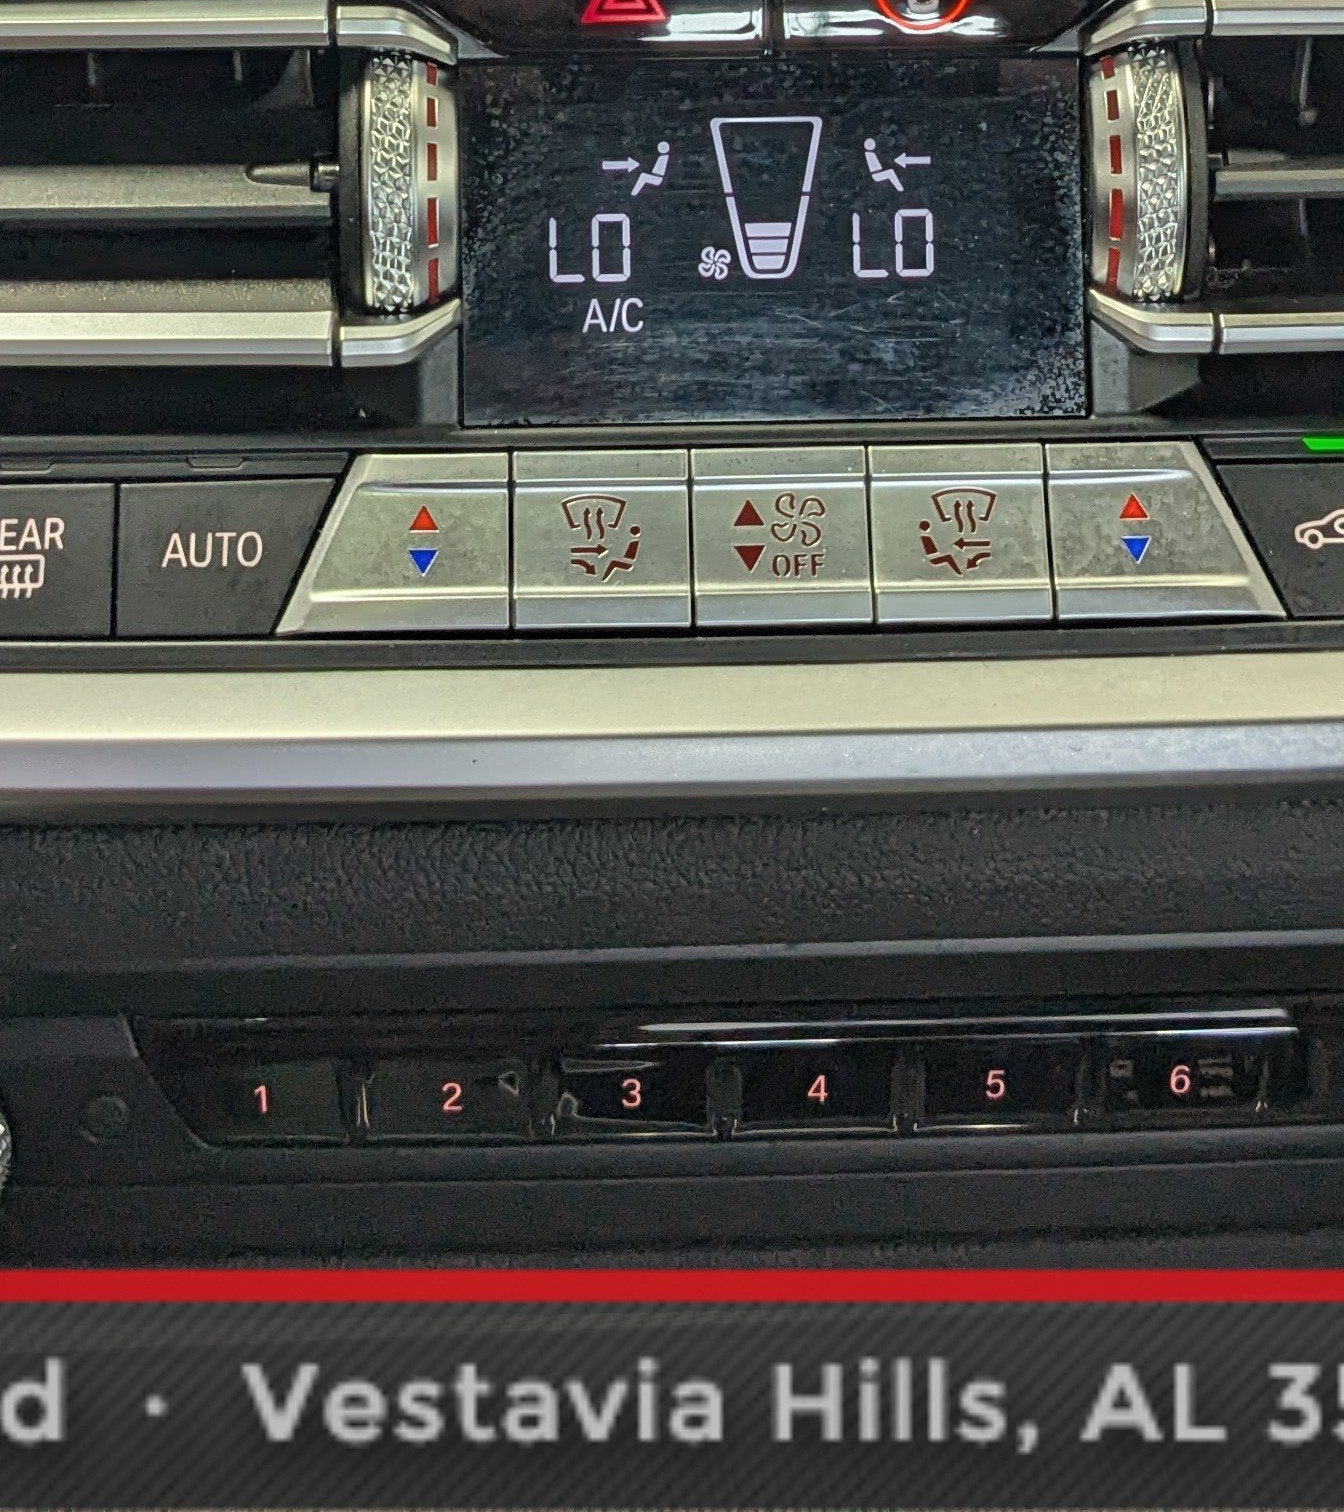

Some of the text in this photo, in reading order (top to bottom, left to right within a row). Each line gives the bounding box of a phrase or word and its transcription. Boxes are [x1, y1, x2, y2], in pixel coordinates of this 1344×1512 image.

[582, 297, 644, 333] A/C
[161, 530, 264, 569] AUTO
[771, 551, 825, 579] OFF
[621, 1078, 642, 1109] 3
[806, 1073, 828, 1104] 4
[985, 1068, 1006, 1100] 5
[1169, 1065, 1191, 1095] 6
[254, 1084, 269, 1115] 1
[441, 1082, 463, 1114] 2
